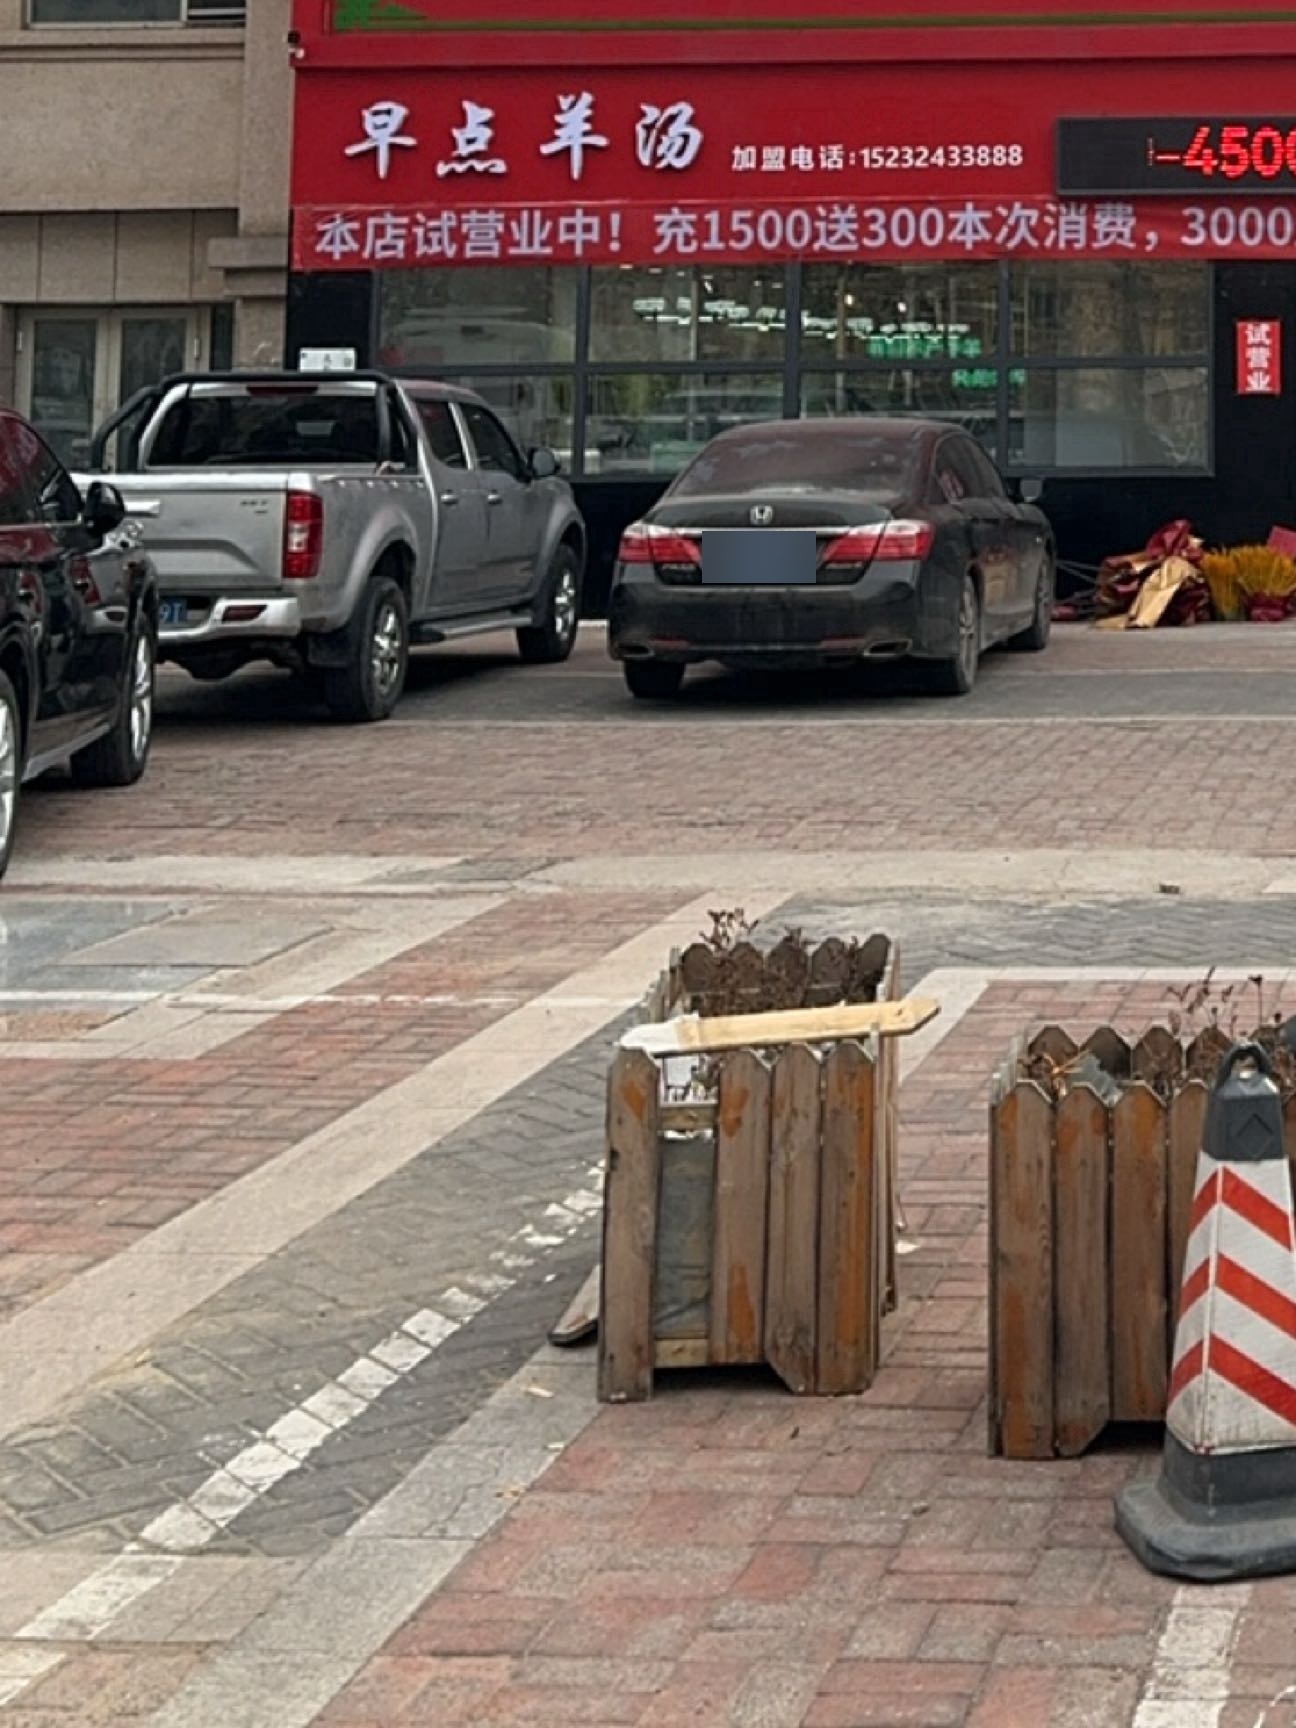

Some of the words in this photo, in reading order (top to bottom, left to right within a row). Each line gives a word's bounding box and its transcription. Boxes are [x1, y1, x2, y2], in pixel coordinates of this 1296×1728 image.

[344, 90, 706, 181] 早点羊汤
[731, 143, 1025, 171] 加盟电话:15232433888
